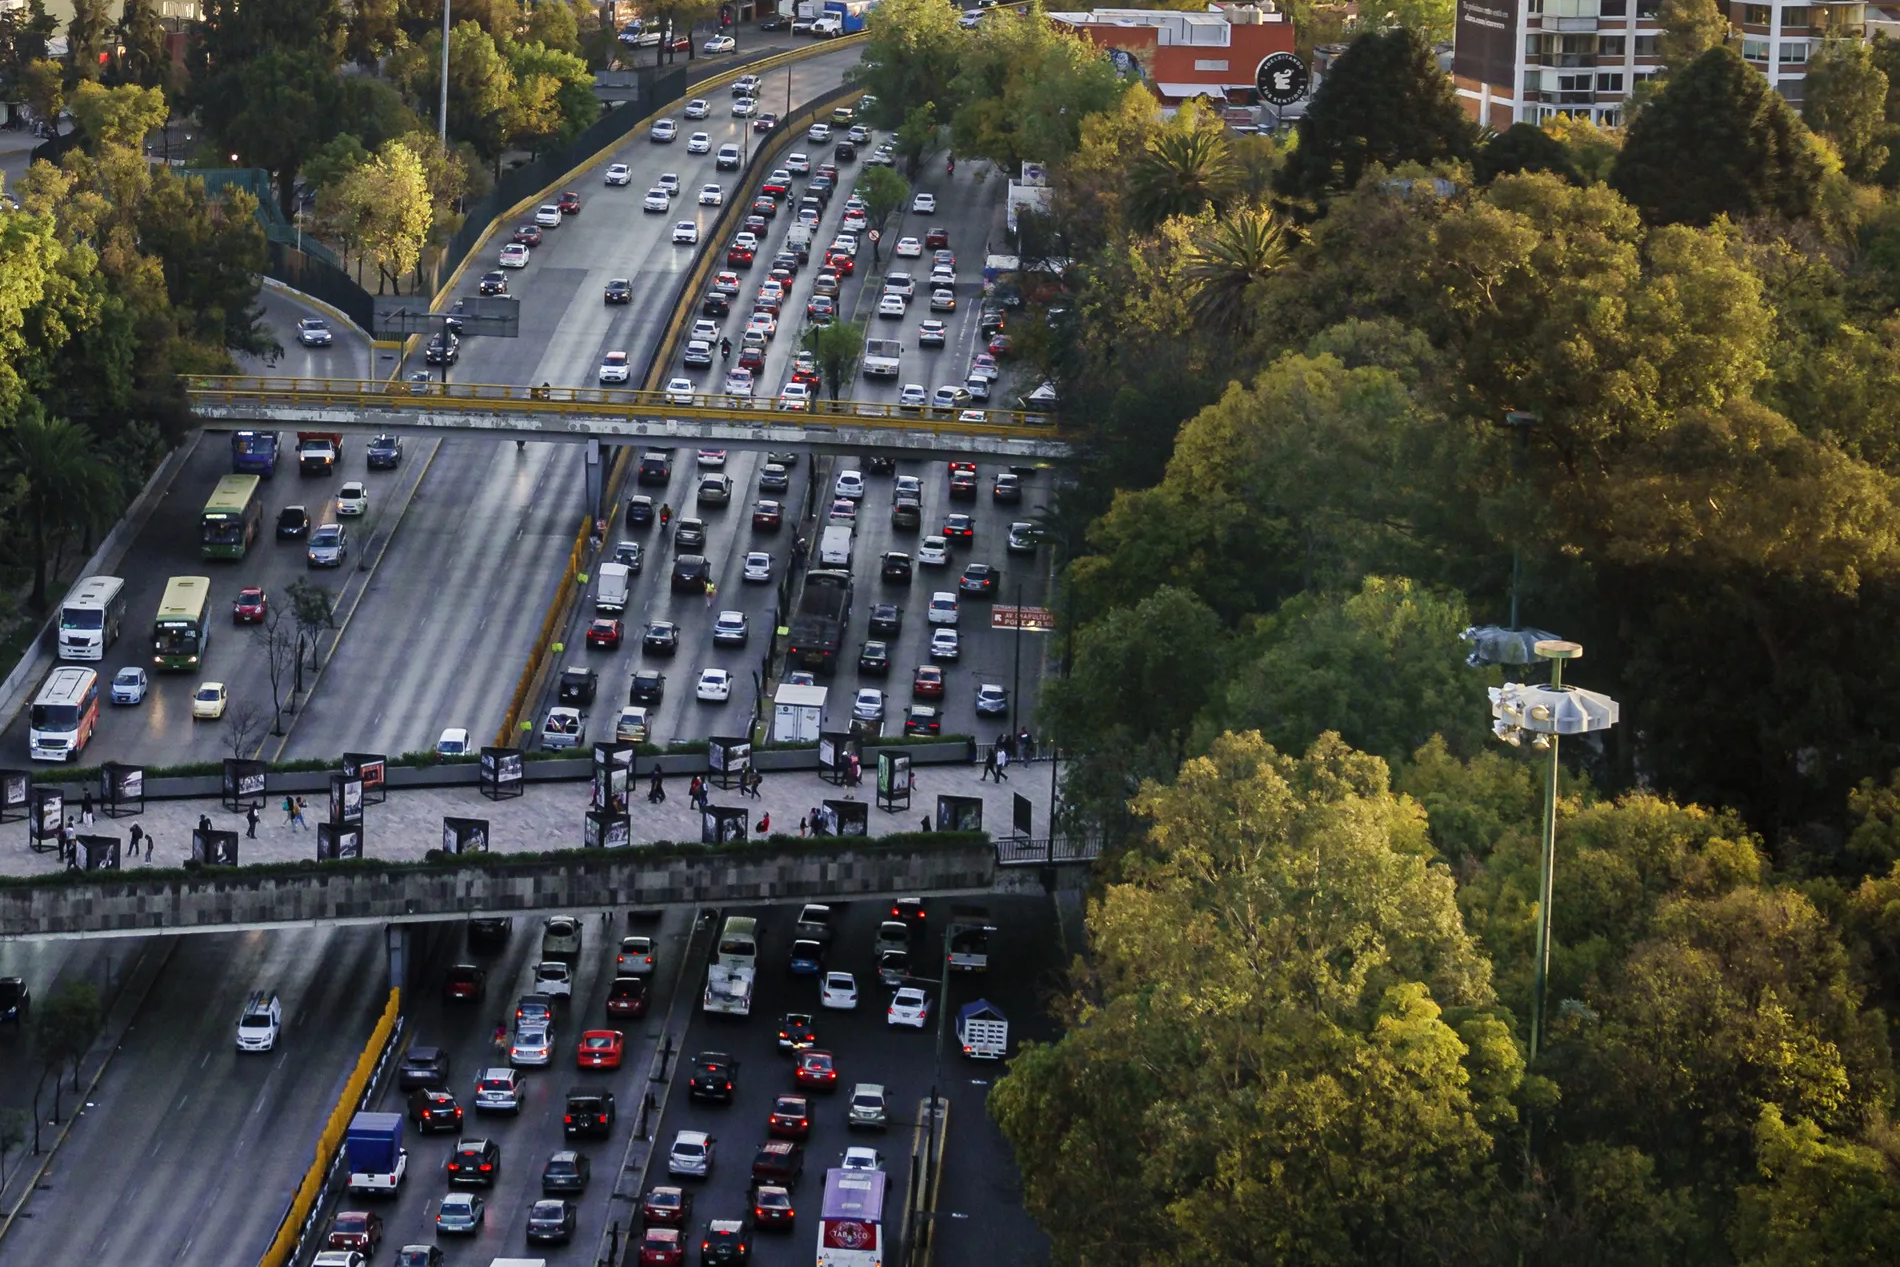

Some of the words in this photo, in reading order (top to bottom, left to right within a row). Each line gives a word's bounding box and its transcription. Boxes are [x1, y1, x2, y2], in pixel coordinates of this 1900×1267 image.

[1262, 85, 1272, 99] TUS
[1272, 85, 1305, 103] SENTIDOS
[833, 1230, 868, 1240] TABSCO
